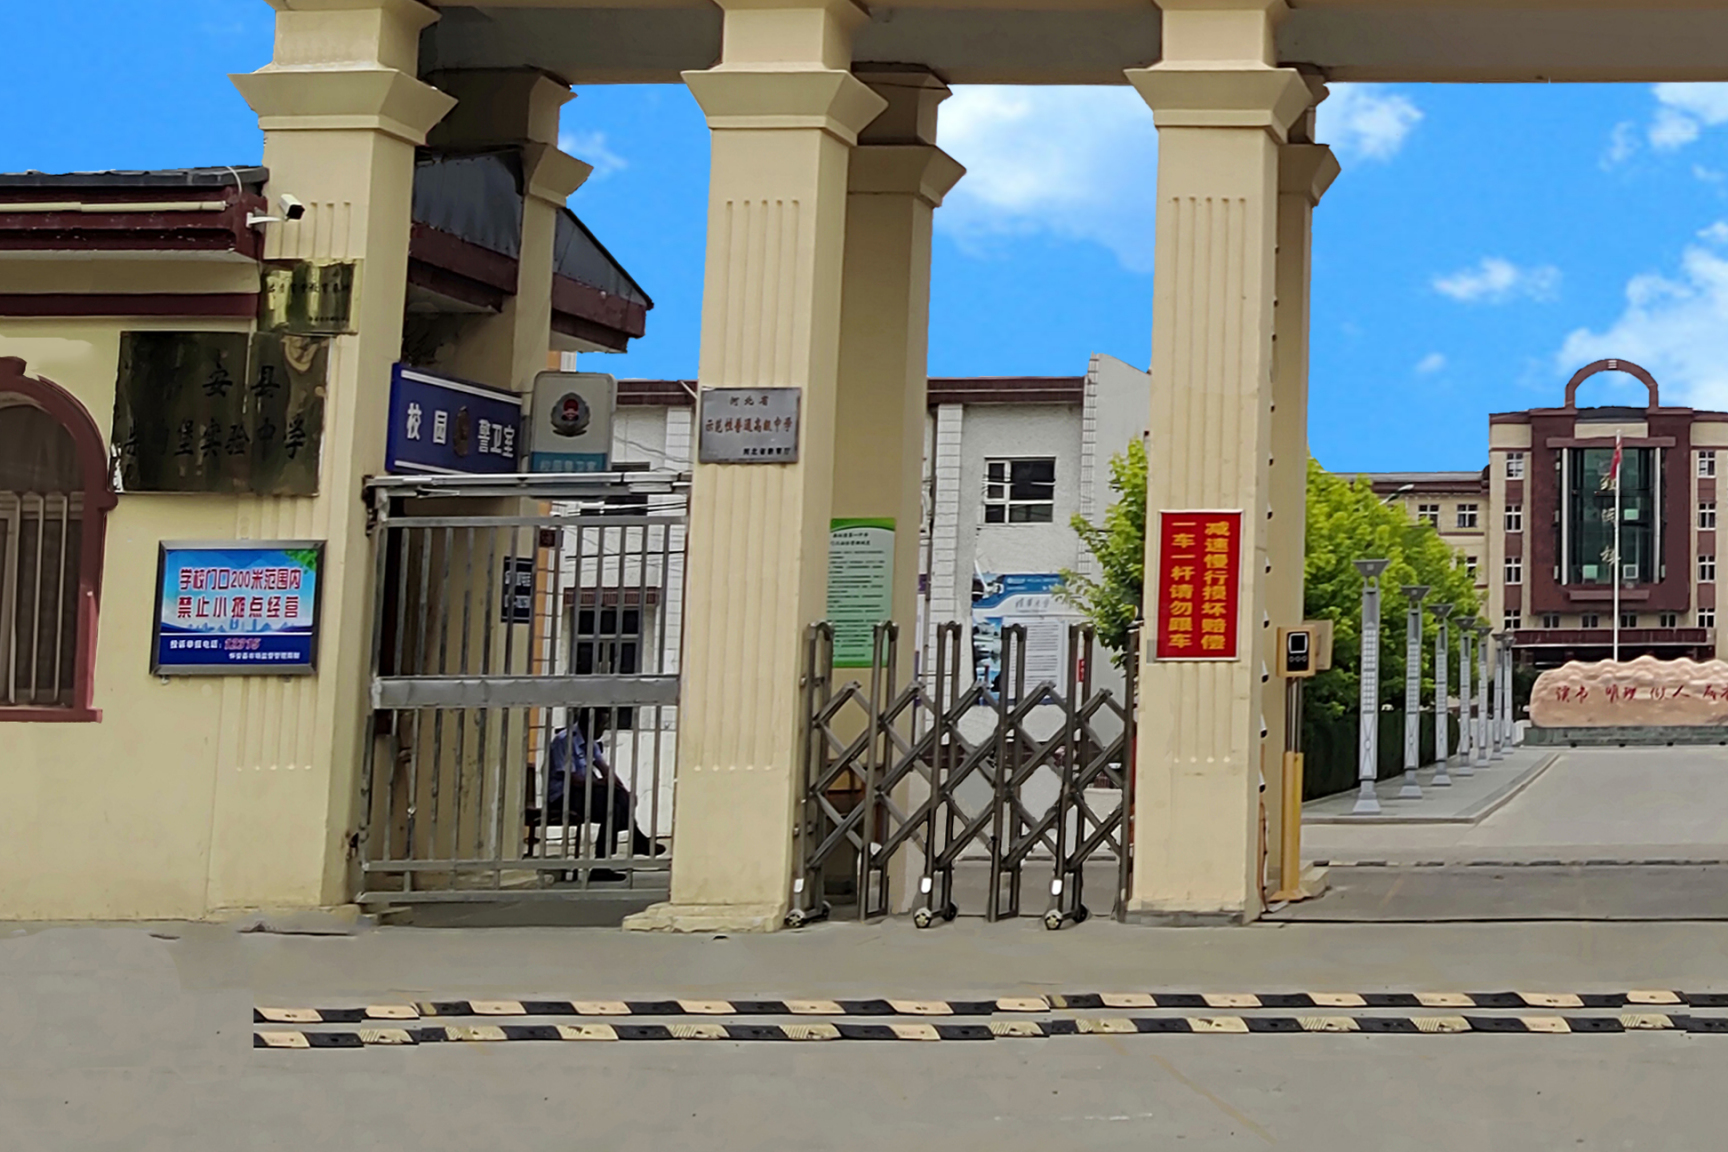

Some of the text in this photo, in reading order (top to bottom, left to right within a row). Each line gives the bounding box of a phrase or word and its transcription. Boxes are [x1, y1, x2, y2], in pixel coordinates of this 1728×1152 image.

[730, 395, 769, 406] 河北省
[122, 414, 307, 460] 堡实验中学
[179, 568, 302, 591] 学校门口200米范围内
[1168, 522, 1197, 648] 一车一杆请勿跟车
[1201, 521, 1231, 650] 减速慢行损坏赔偿
[177, 596, 299, 619] 禁止小摊点经营
